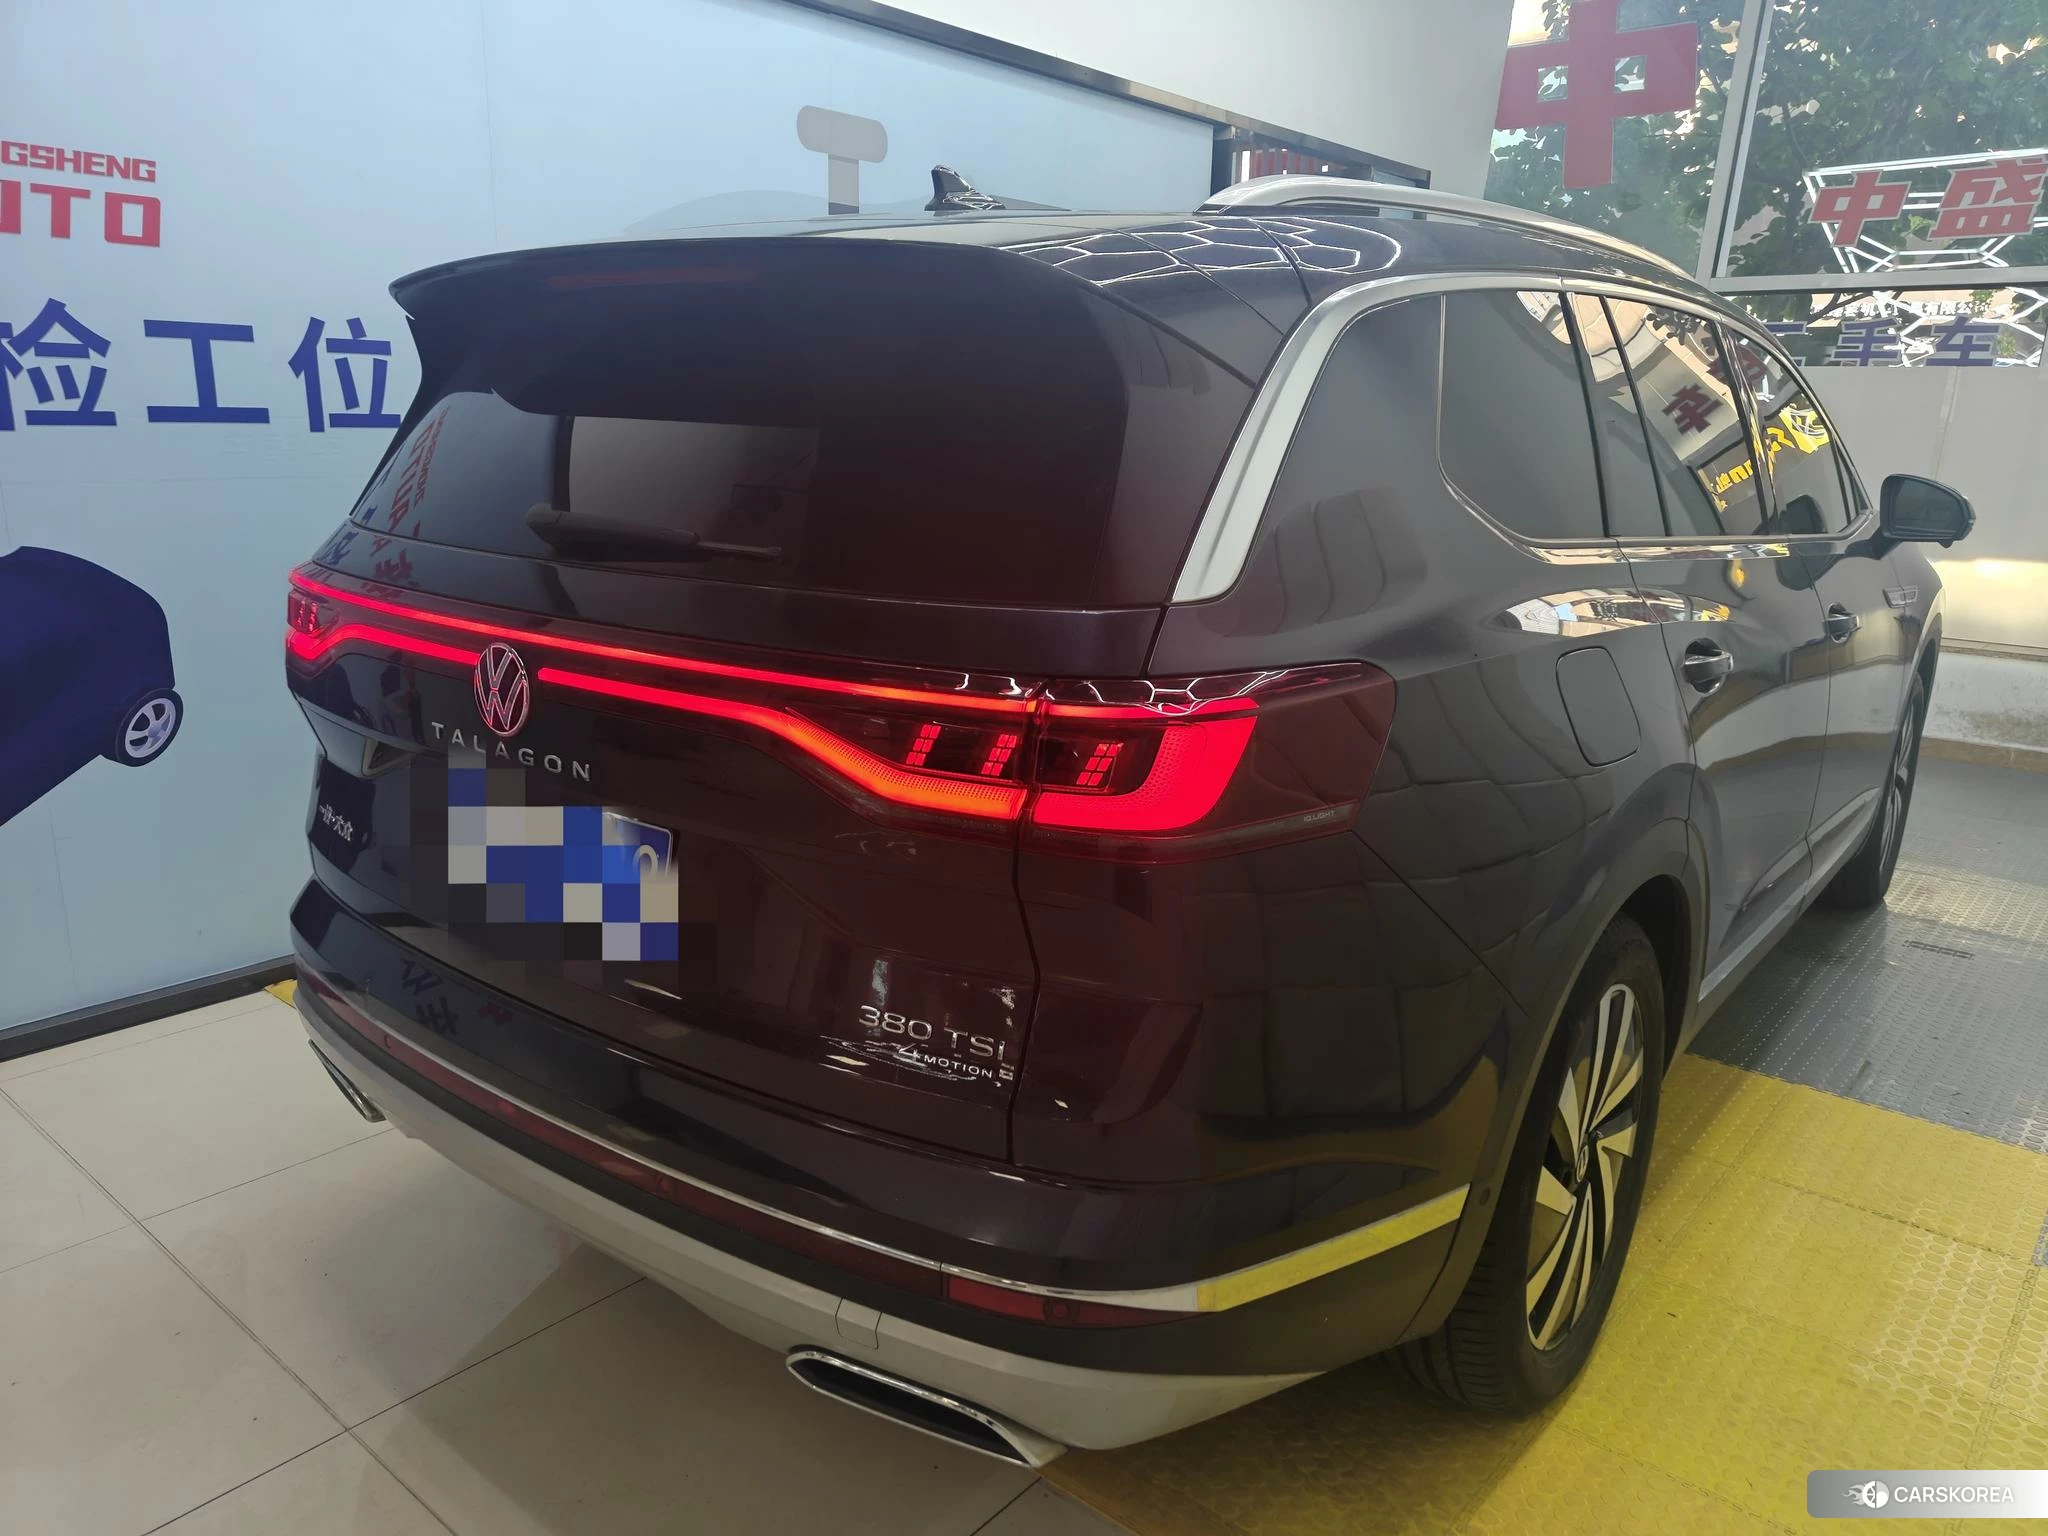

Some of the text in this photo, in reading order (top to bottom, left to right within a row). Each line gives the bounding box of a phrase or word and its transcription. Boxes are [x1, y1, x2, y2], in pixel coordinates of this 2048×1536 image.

[1, 141, 156, 183] GSHENG
[1808, 156, 2048, 247] 中盛
[431, 721, 592, 782] TALAGON
[860, 1004, 1006, 1061] 380 TSI
